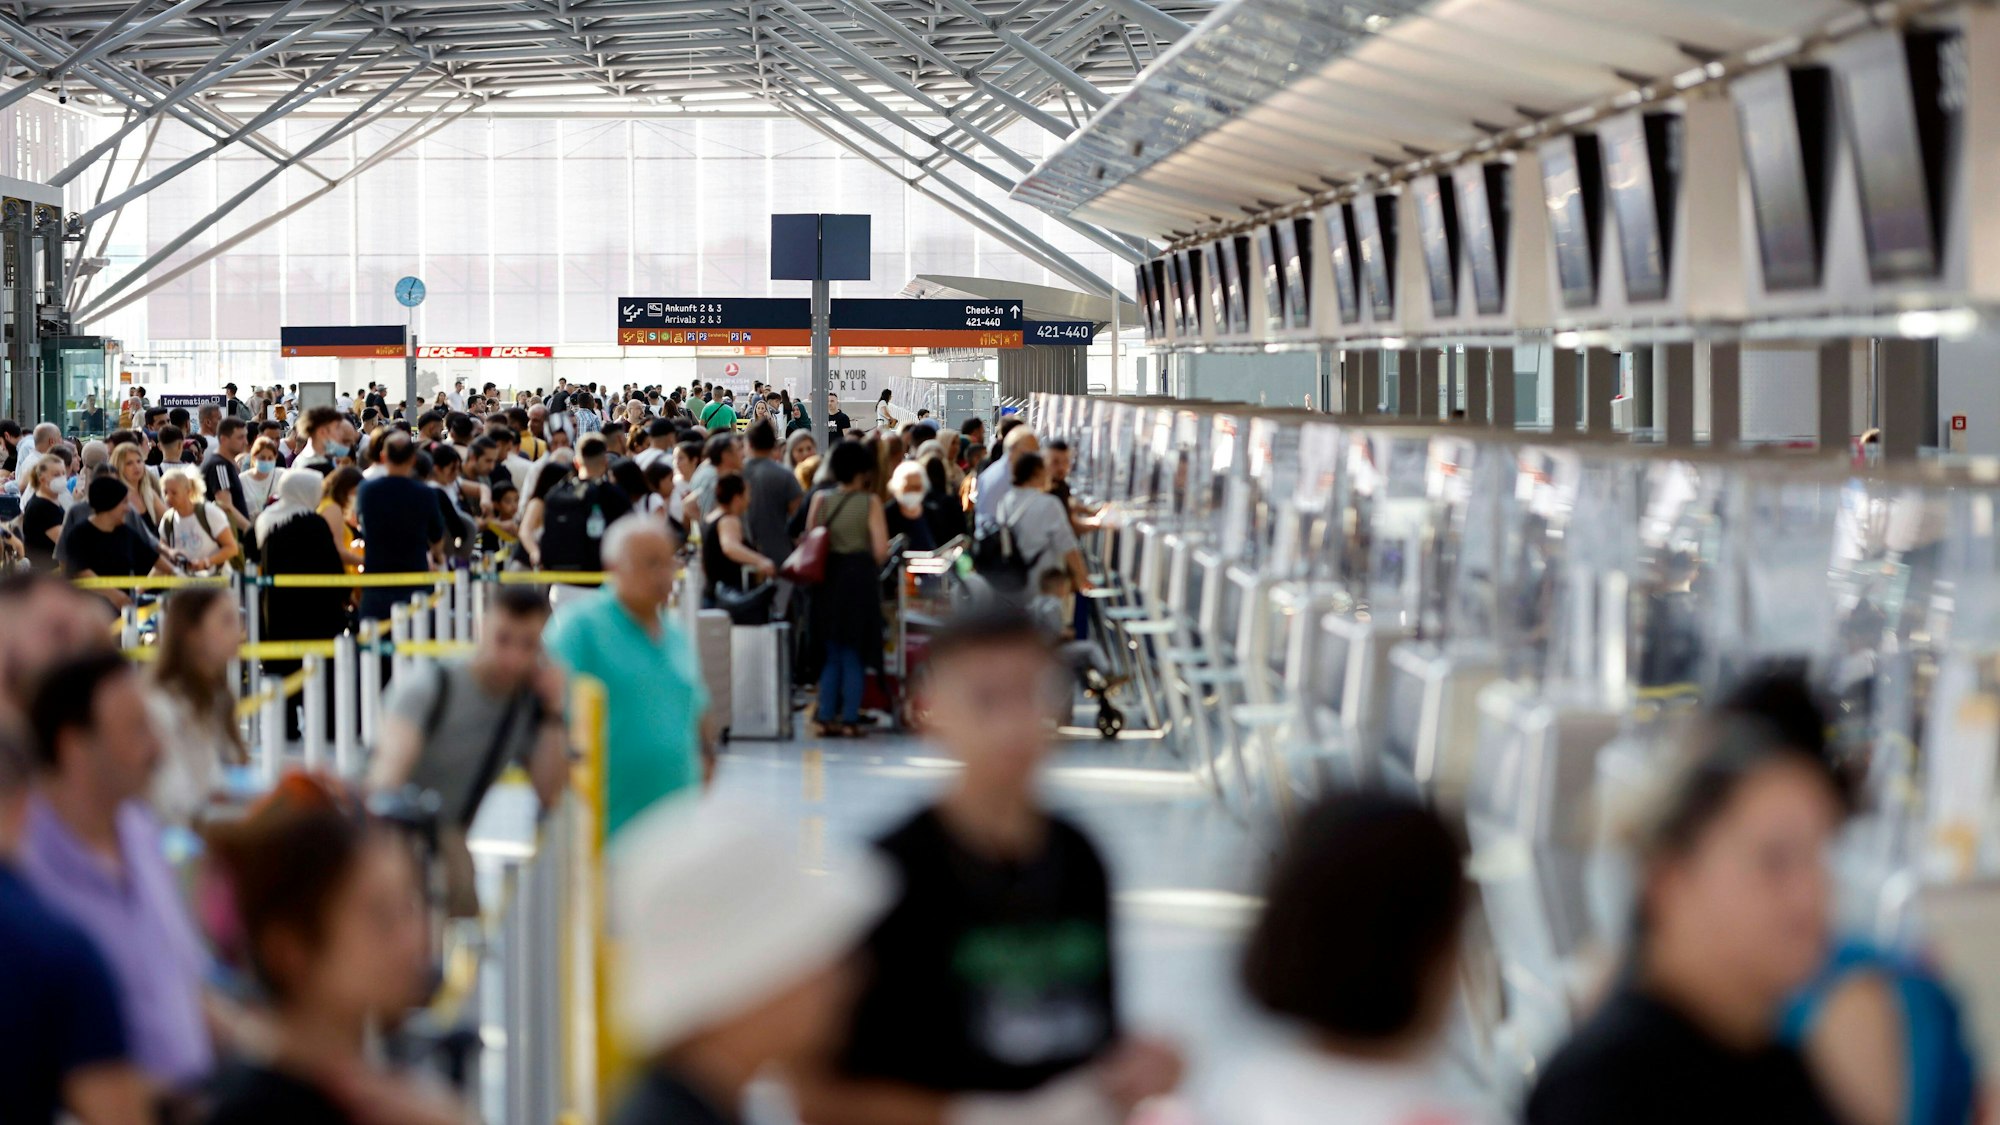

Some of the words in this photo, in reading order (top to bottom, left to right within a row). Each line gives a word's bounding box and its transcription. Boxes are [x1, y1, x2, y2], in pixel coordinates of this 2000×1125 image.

[665, 304, 697, 313] Ankunft
[700, 304, 706, 312] 2
[708, 304, 715, 312] &
[716, 304, 722, 312] 3
[965, 305, 1004, 315] Check-in
[665, 315, 697, 324] Arrivals
[700, 315, 706, 324] 2
[708, 315, 715, 324] &
[716, 315, 722, 324] 3
[965, 317, 1001, 327] 421-440
[1036, 325, 1089, 339] 421-440
[429, 346, 457, 357] CAS
[501, 346, 529, 357] CAS
[829, 369, 840, 380] EN
[845, 369, 867, 380] YOUR
[829, 380, 867, 391] ORLD
[163, 397, 210, 406] Information
